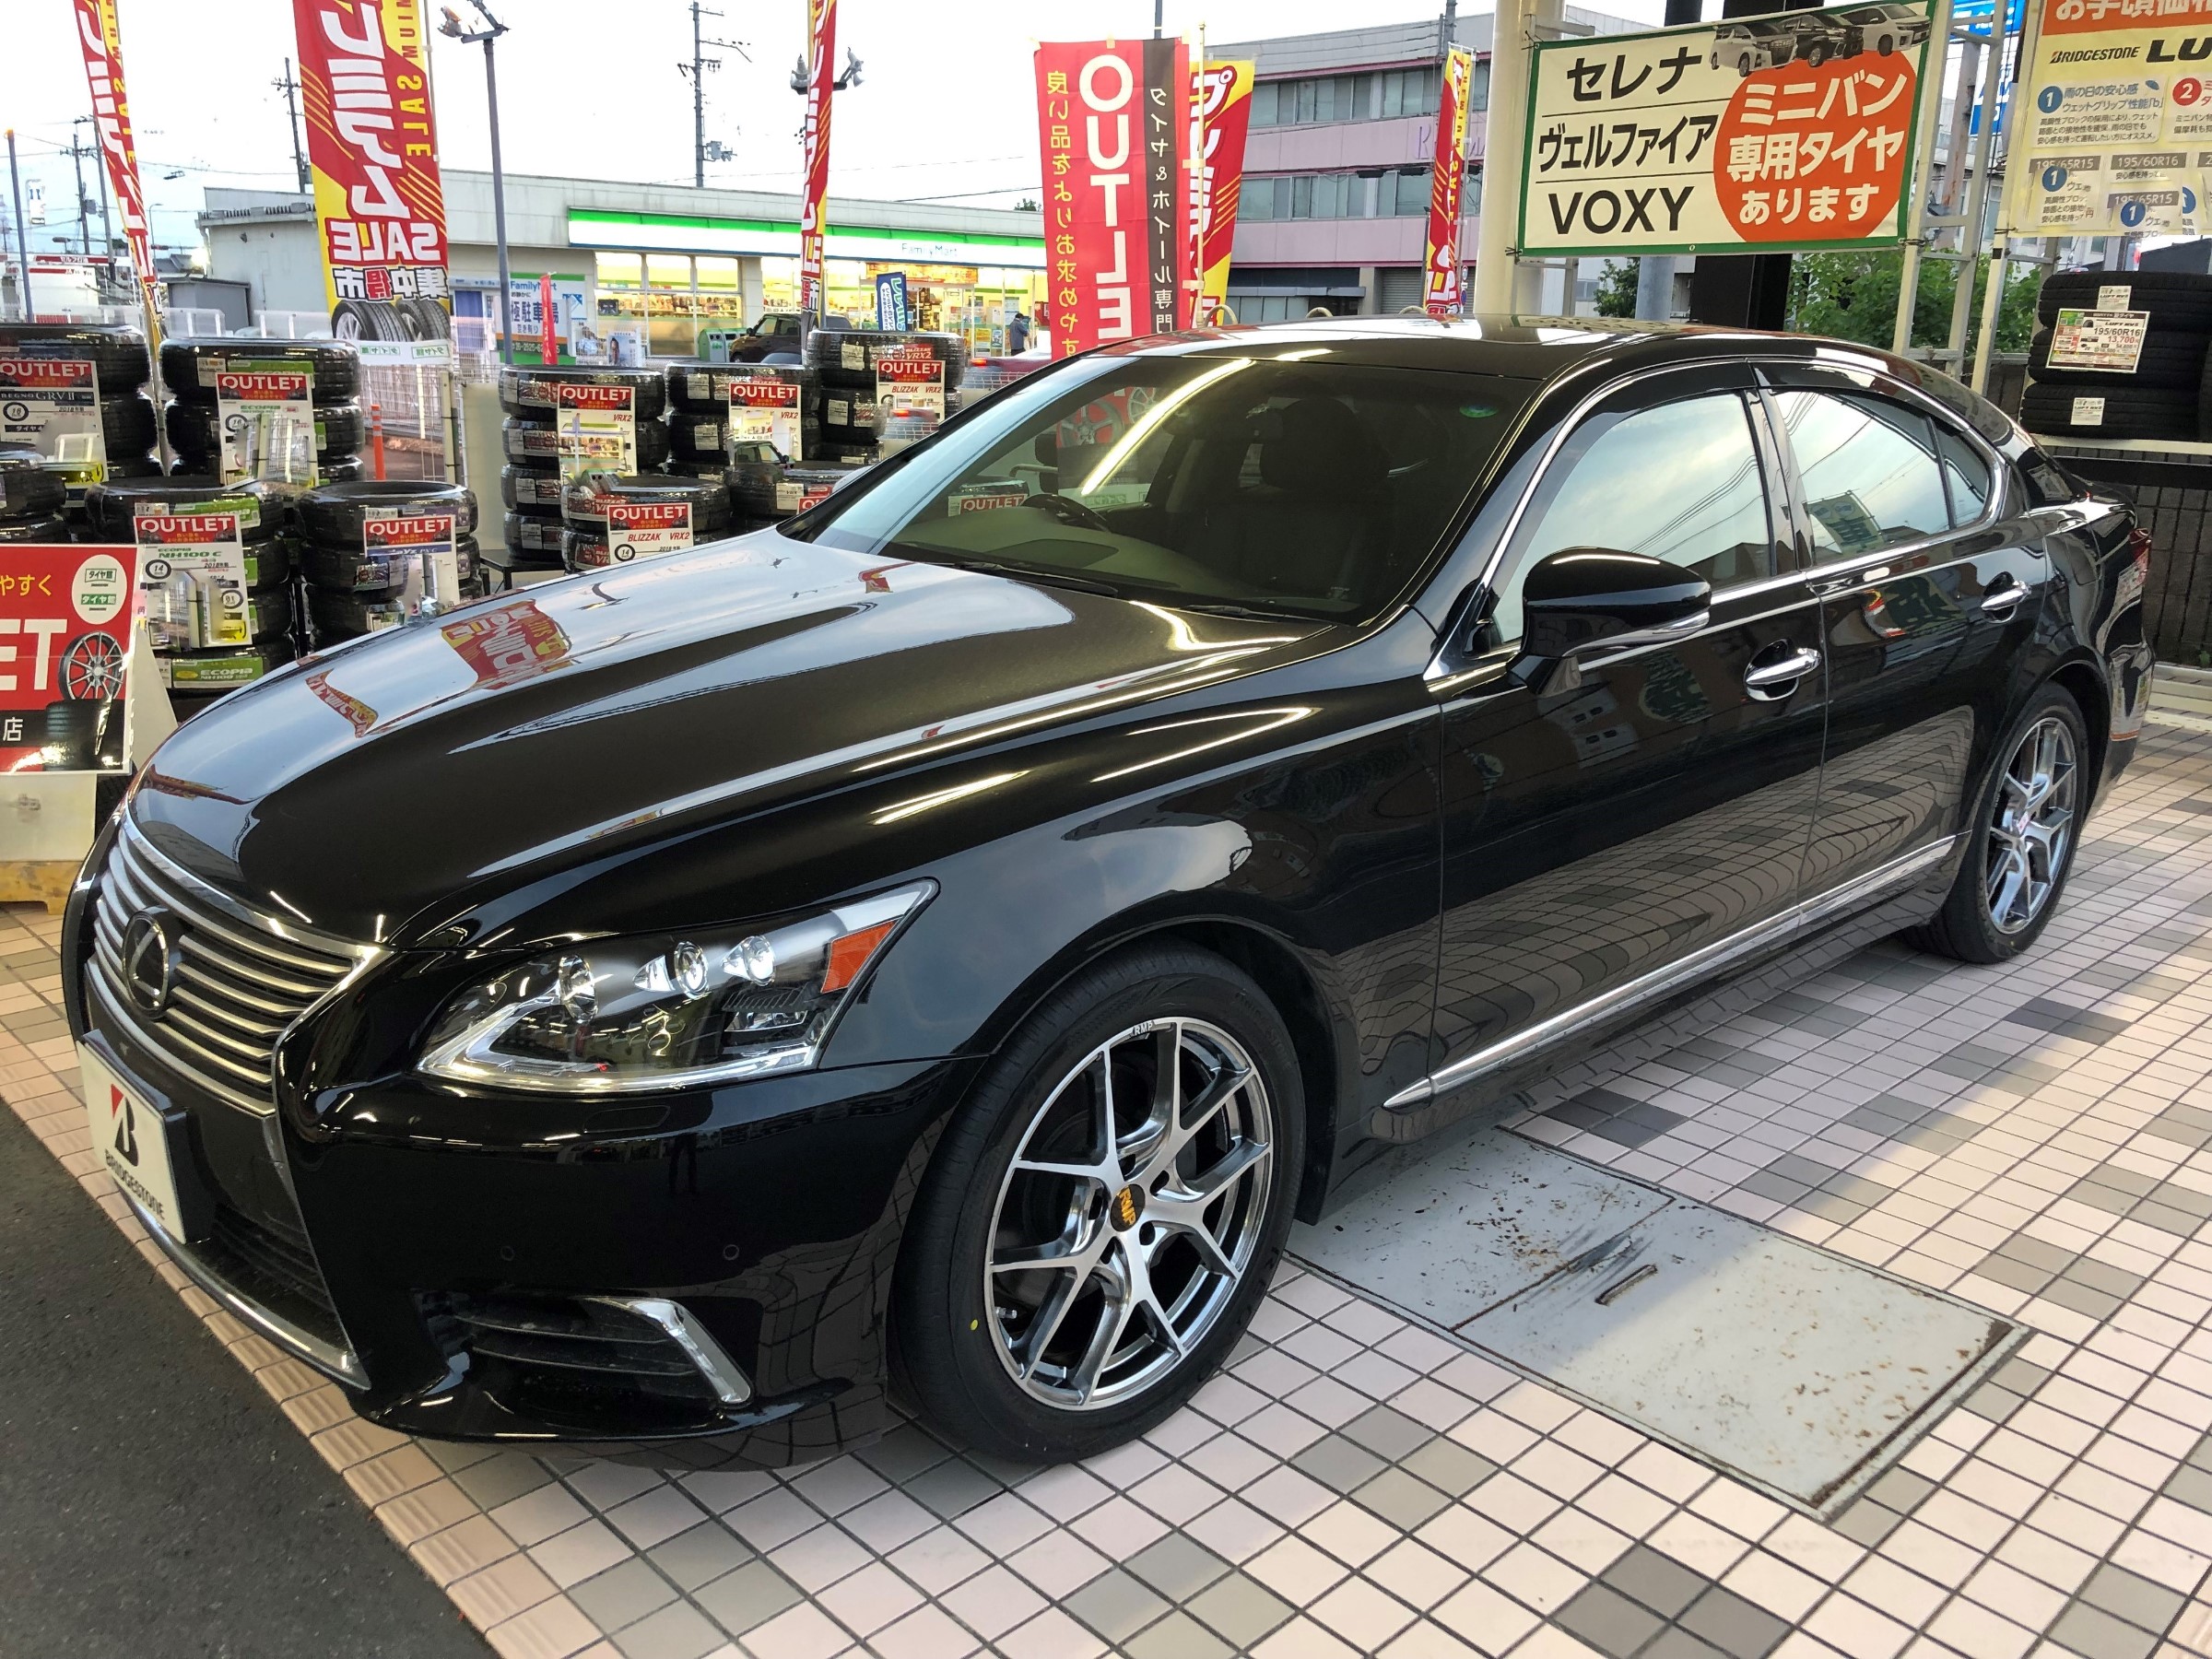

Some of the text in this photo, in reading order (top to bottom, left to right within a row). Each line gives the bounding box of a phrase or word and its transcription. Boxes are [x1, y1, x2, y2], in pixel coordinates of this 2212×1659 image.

[2049, 46, 2141, 64] BRIDGESTONE
[1566, 47, 1702, 102] セレナ
[1739, 69, 1908, 126] ミニバン
[2064, 83, 2139, 100] 雨の日の安心感
[1538, 114, 1719, 173] ヴェルファイア
[1726, 124, 1905, 183] 専用タイヤ
[2117, 156, 2179, 168] 195/60R16
[1548, 186, 1694, 235] VOXY
[1739, 182, 1880, 227] あります
[2093, 327, 2142, 337] 195/60R16
[0, 362, 89, 377] OUTLET
[880, 361, 941, 374] OUTLET
[221, 375, 304, 391] OUTLET
[562, 387, 630, 402] OUTLET
[733, 385, 796, 399] OUTLET
[613, 414, 633, 422] VRX2
[781, 411, 799, 419] VRX2
[963, 496, 1024, 512] OUTLET
[612, 506, 687, 521] OUTLET
[140, 517, 232, 534] OUTLET
[369, 518, 449, 535] OUTLET
[628, 532, 690, 542] BLIZZAK VRX2
[88, 570, 115, 581] タイヤ館
[80, 594, 117, 606] タイヤ館
[3, 717, 24, 743] 店
[1133, 1020, 1155, 1037] RMP
[104, 1148, 166, 1221] BRIDGESTONE
